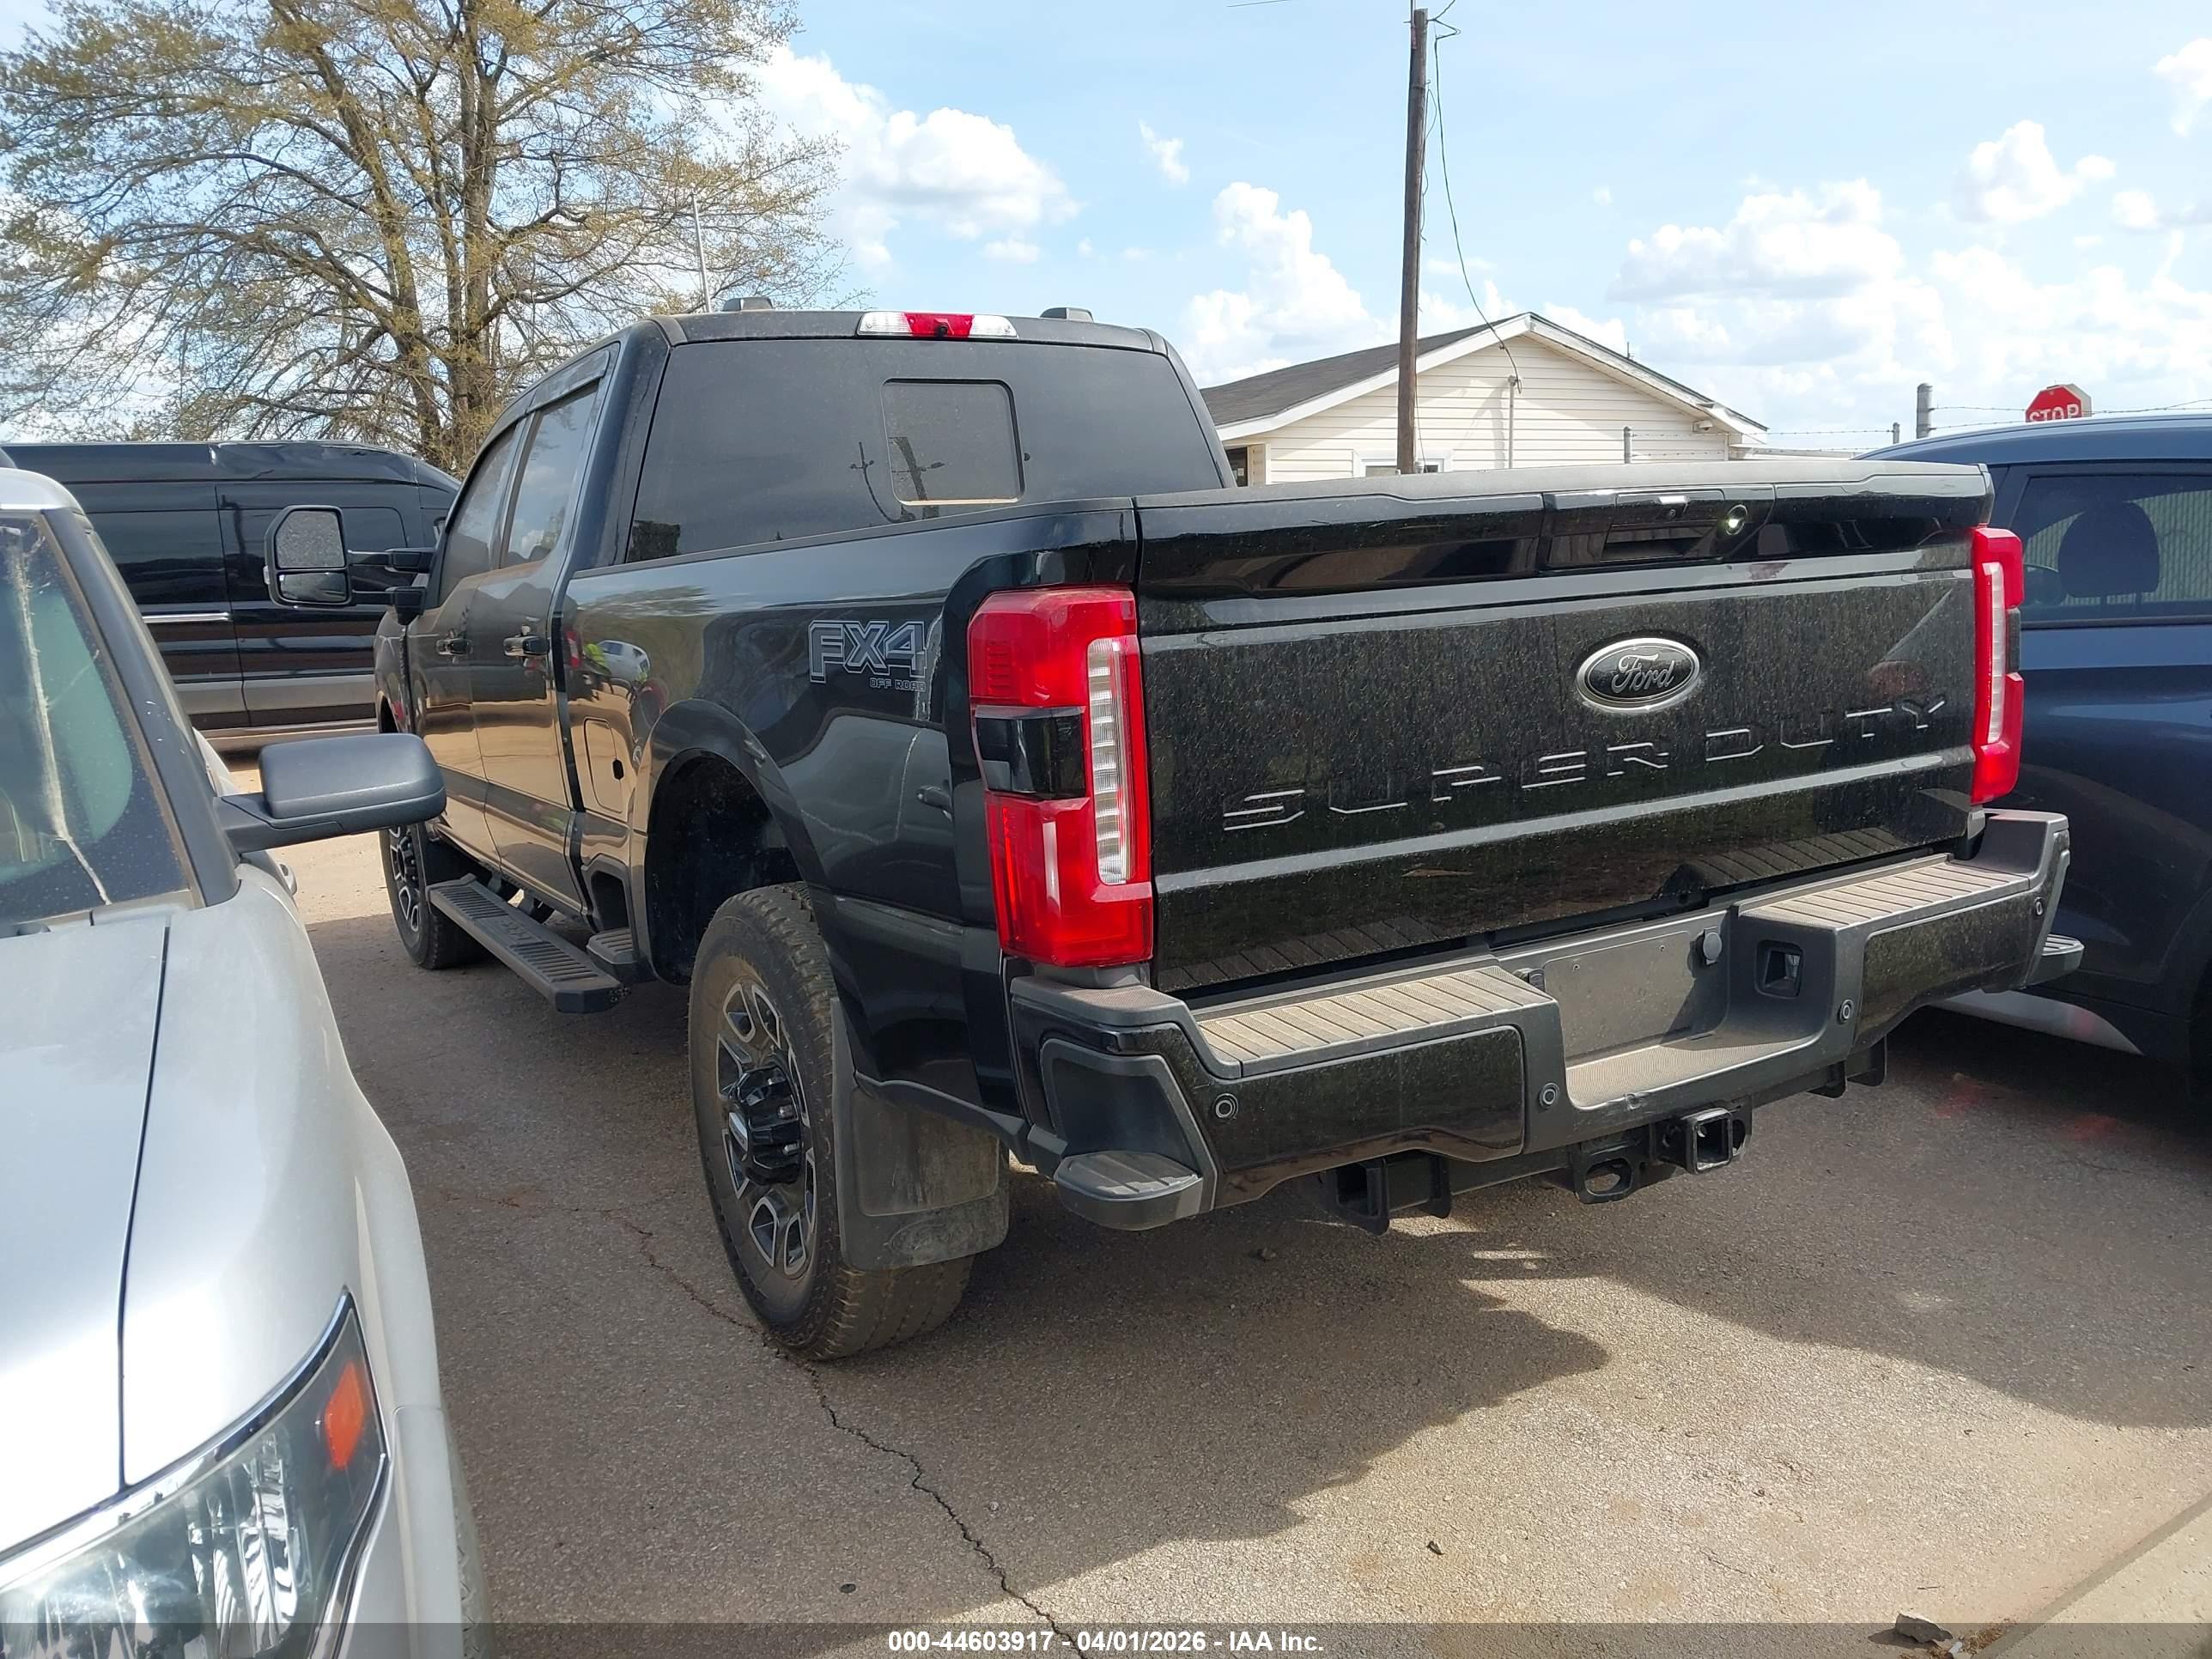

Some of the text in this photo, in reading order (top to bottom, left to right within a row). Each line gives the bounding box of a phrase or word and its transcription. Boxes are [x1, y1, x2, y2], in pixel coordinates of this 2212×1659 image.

[808, 619, 927, 684] FX4
[1611, 653, 1676, 694] Ford
[869, 677, 926, 692] OFF ROAD
[1223, 695, 1947, 830] SUPER DUTY
